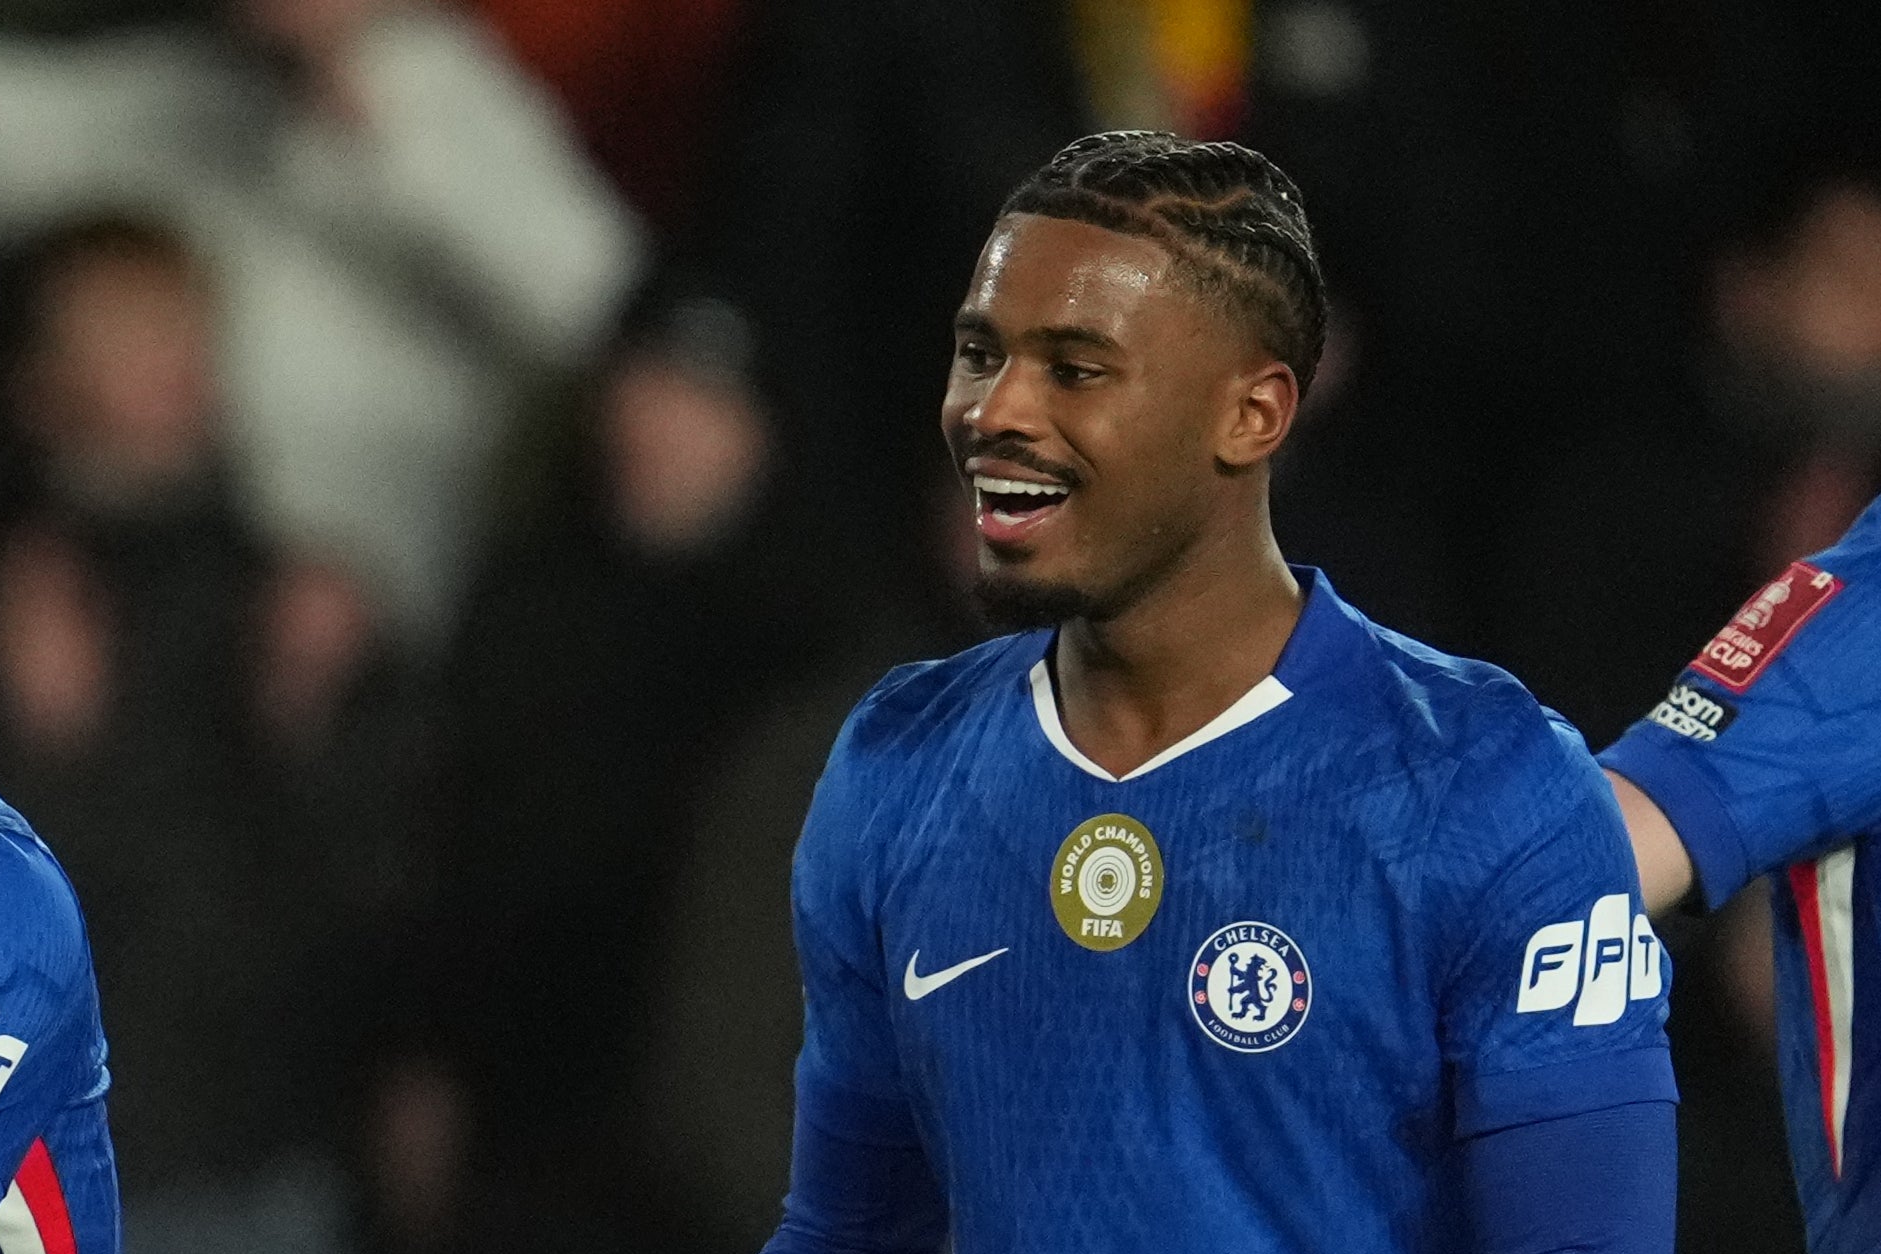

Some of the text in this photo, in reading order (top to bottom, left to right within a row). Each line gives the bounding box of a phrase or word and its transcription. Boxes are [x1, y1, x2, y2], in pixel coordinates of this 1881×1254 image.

[1708, 641, 1754, 670] CUP
[1666, 684, 1725, 727] oom
[1059, 825, 1154, 900] WORLD CHAMPIONS
[1080, 918, 1124, 939] FIFA
[1212, 926, 1291, 958] CHELSEA
